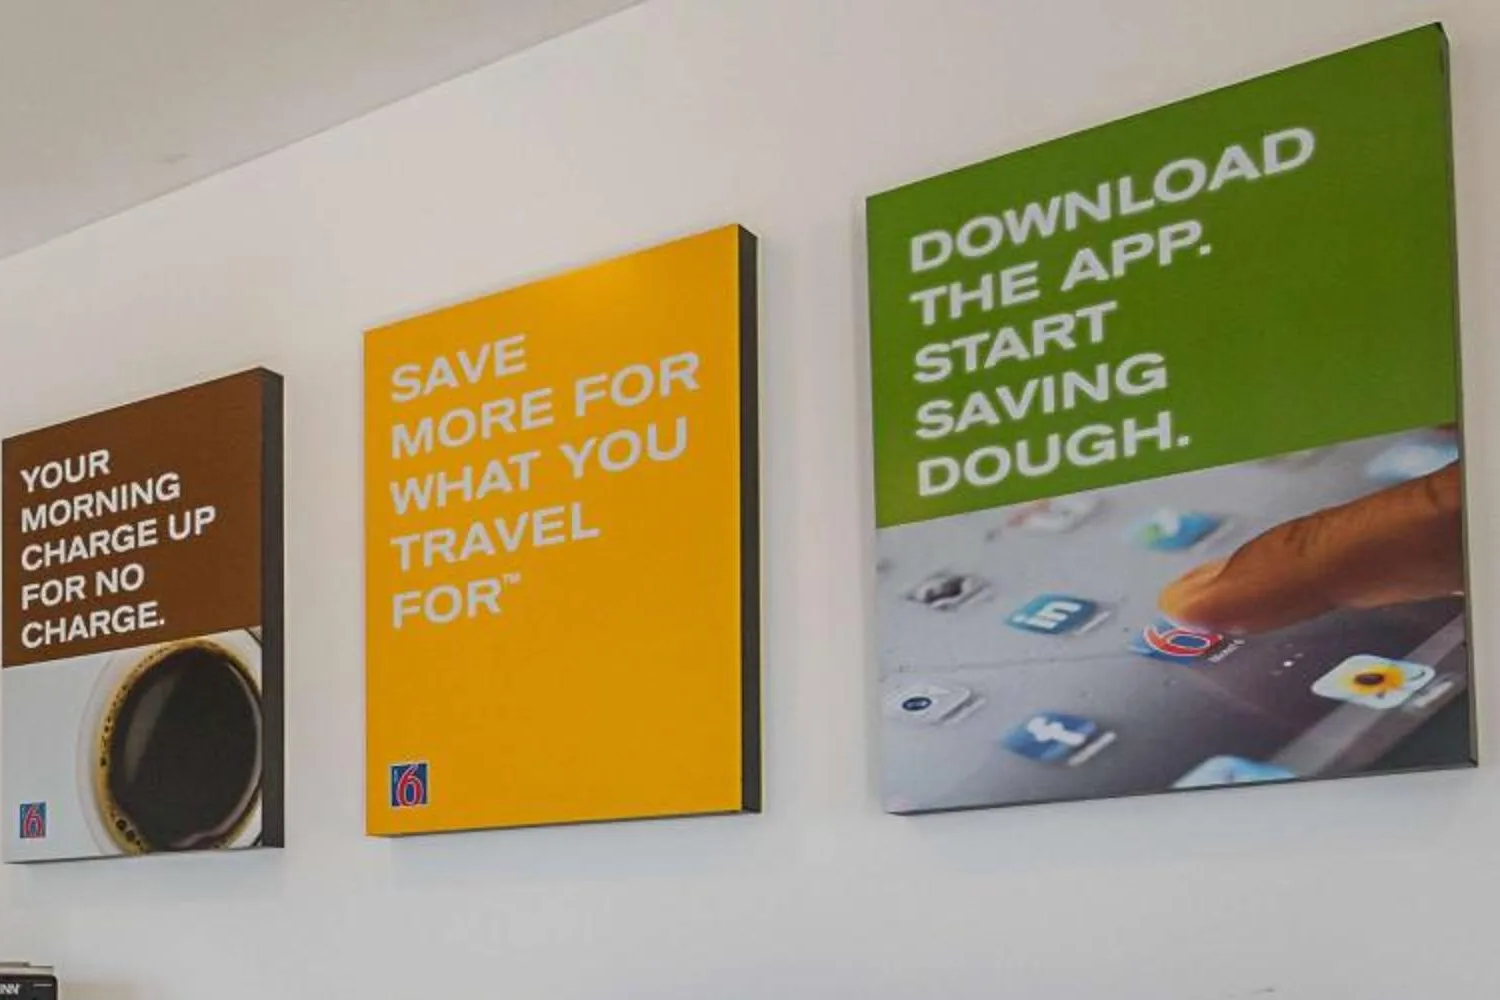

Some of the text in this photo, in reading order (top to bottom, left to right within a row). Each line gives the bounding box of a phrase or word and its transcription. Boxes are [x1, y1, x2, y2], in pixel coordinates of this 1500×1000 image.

[910, 127, 1316, 272] DOWNLOAD
[910, 219, 1211, 326] THE APP.
[391, 334, 527, 403] SAVE
[913, 301, 1118, 383] START
[391, 352, 700, 460] MORE FOR
[915, 352, 1169, 440] SAVING
[20, 449, 110, 493] YOUR
[389, 416, 687, 515] WHAT YOU
[917, 411, 1190, 497] DOUGH.
[21, 472, 181, 533] MORNING
[389, 502, 601, 571] TRAVEL
[21, 505, 216, 571] CHARGE UP
[21, 563, 145, 611] FOR NO
[1011, 600, 1082, 629] in
[21, 601, 165, 649] CHARGE.
[395, 764, 426, 807] 6
